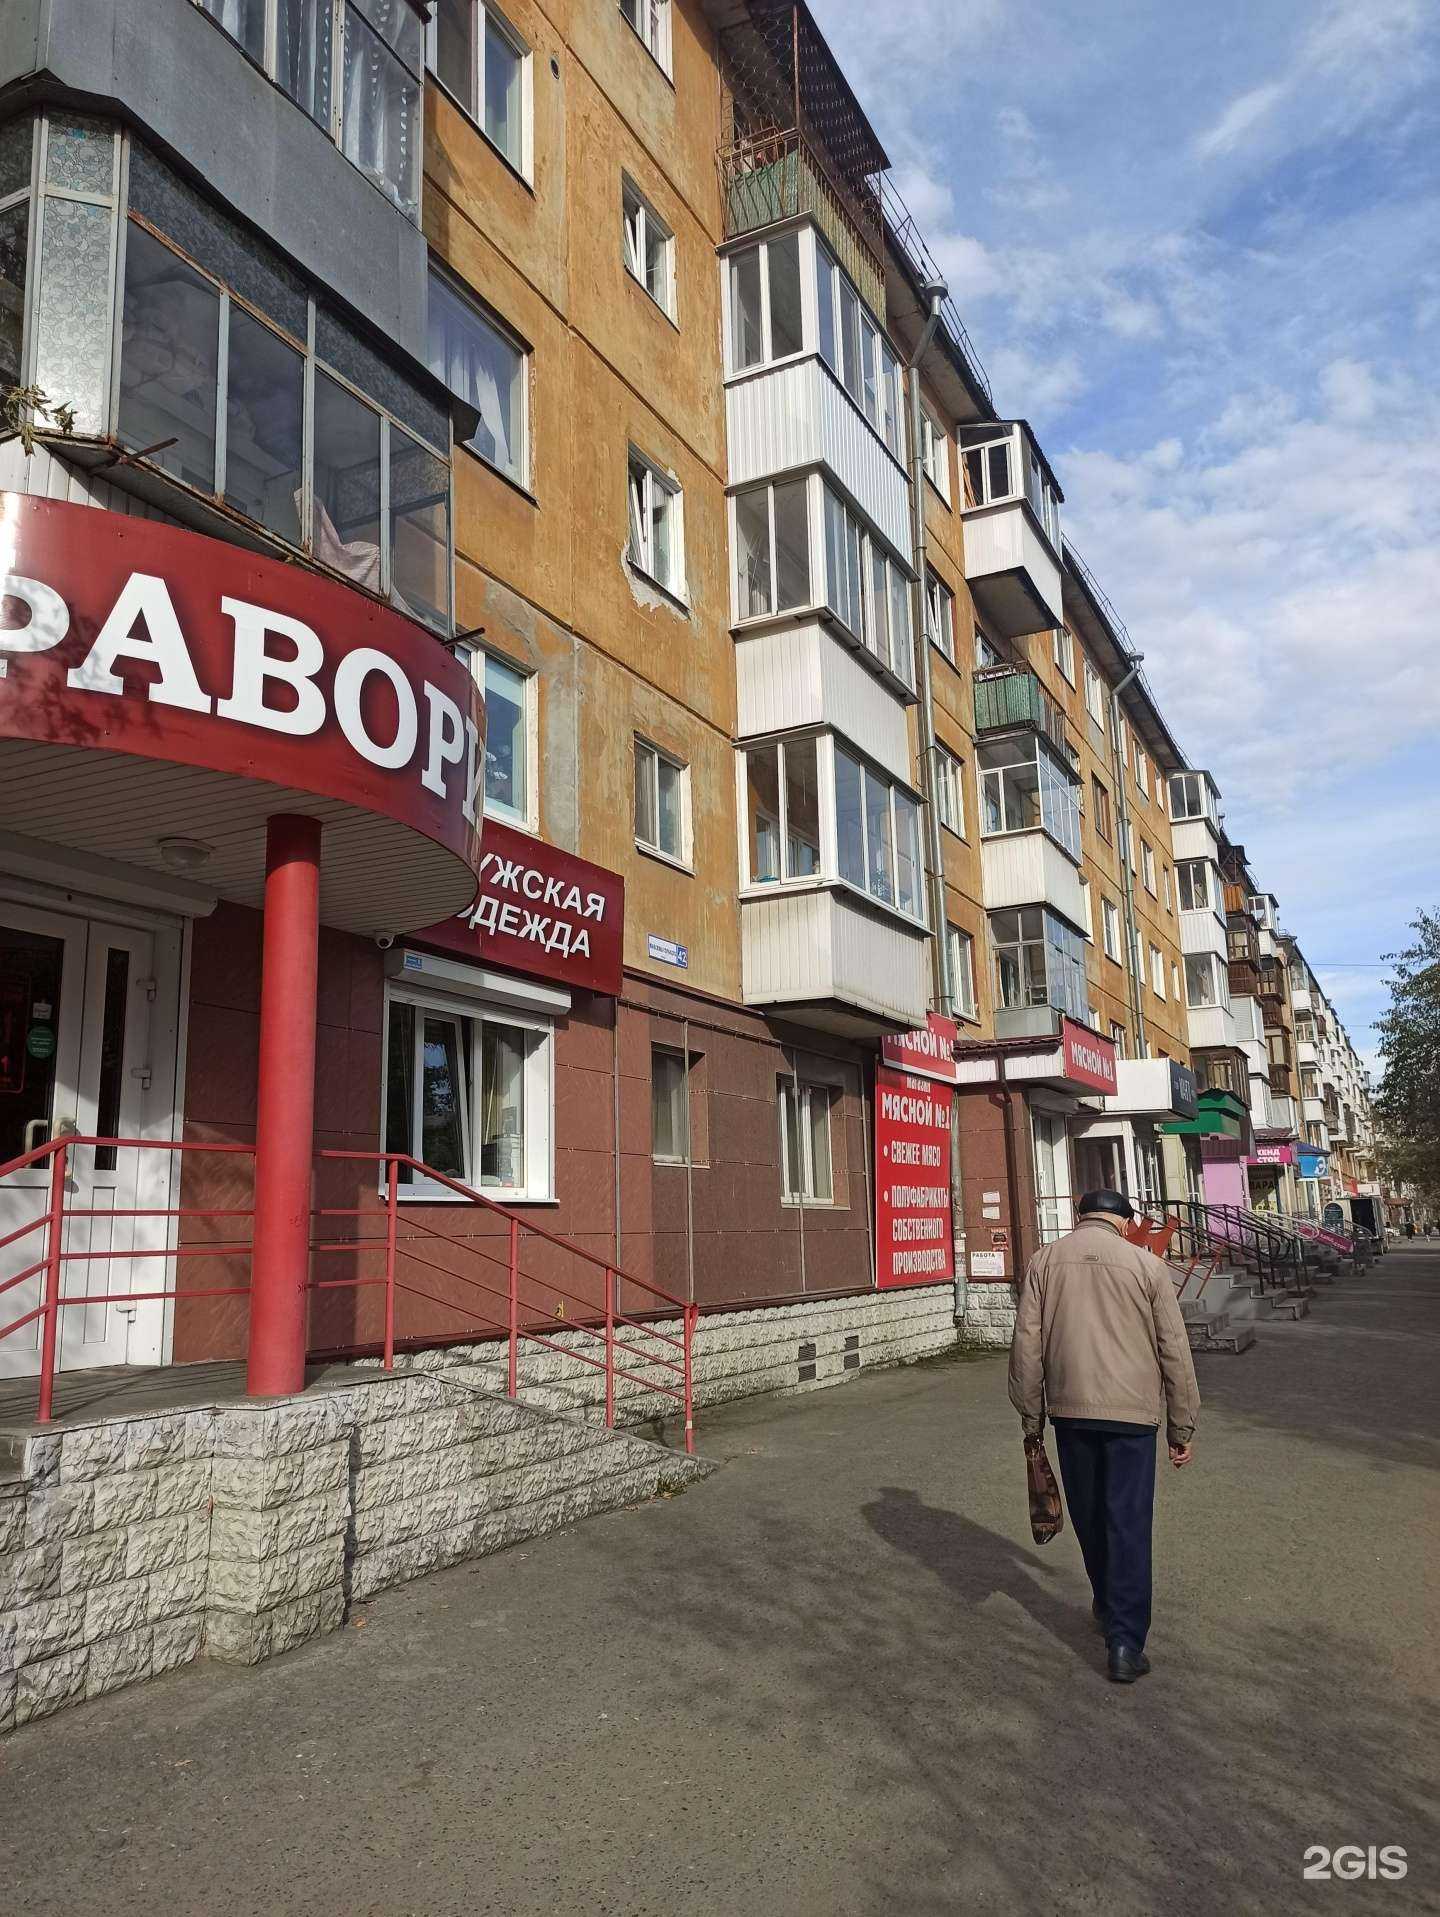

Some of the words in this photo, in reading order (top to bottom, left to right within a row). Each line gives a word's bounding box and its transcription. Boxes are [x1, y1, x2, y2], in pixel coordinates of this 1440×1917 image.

[456, 894, 591, 959] ДЕЖДА
[1071, 1040, 1102, 1077] МЯСНОЙ
[881, 1092, 933, 1127] МЯСНОЙ
[935, 1103, 951, 1130] №1
[891, 1140, 920, 1165] СВЕЖЕЕ
[922, 1144, 941, 1167] МЯСО
[891, 1185, 950, 1208] ПОЛУФАБРИКАТЫ
[892, 1217, 944, 1241] СОБСТВЕННОГО
[893, 1248, 946, 1275] ПРОИЗВОДСТВА
